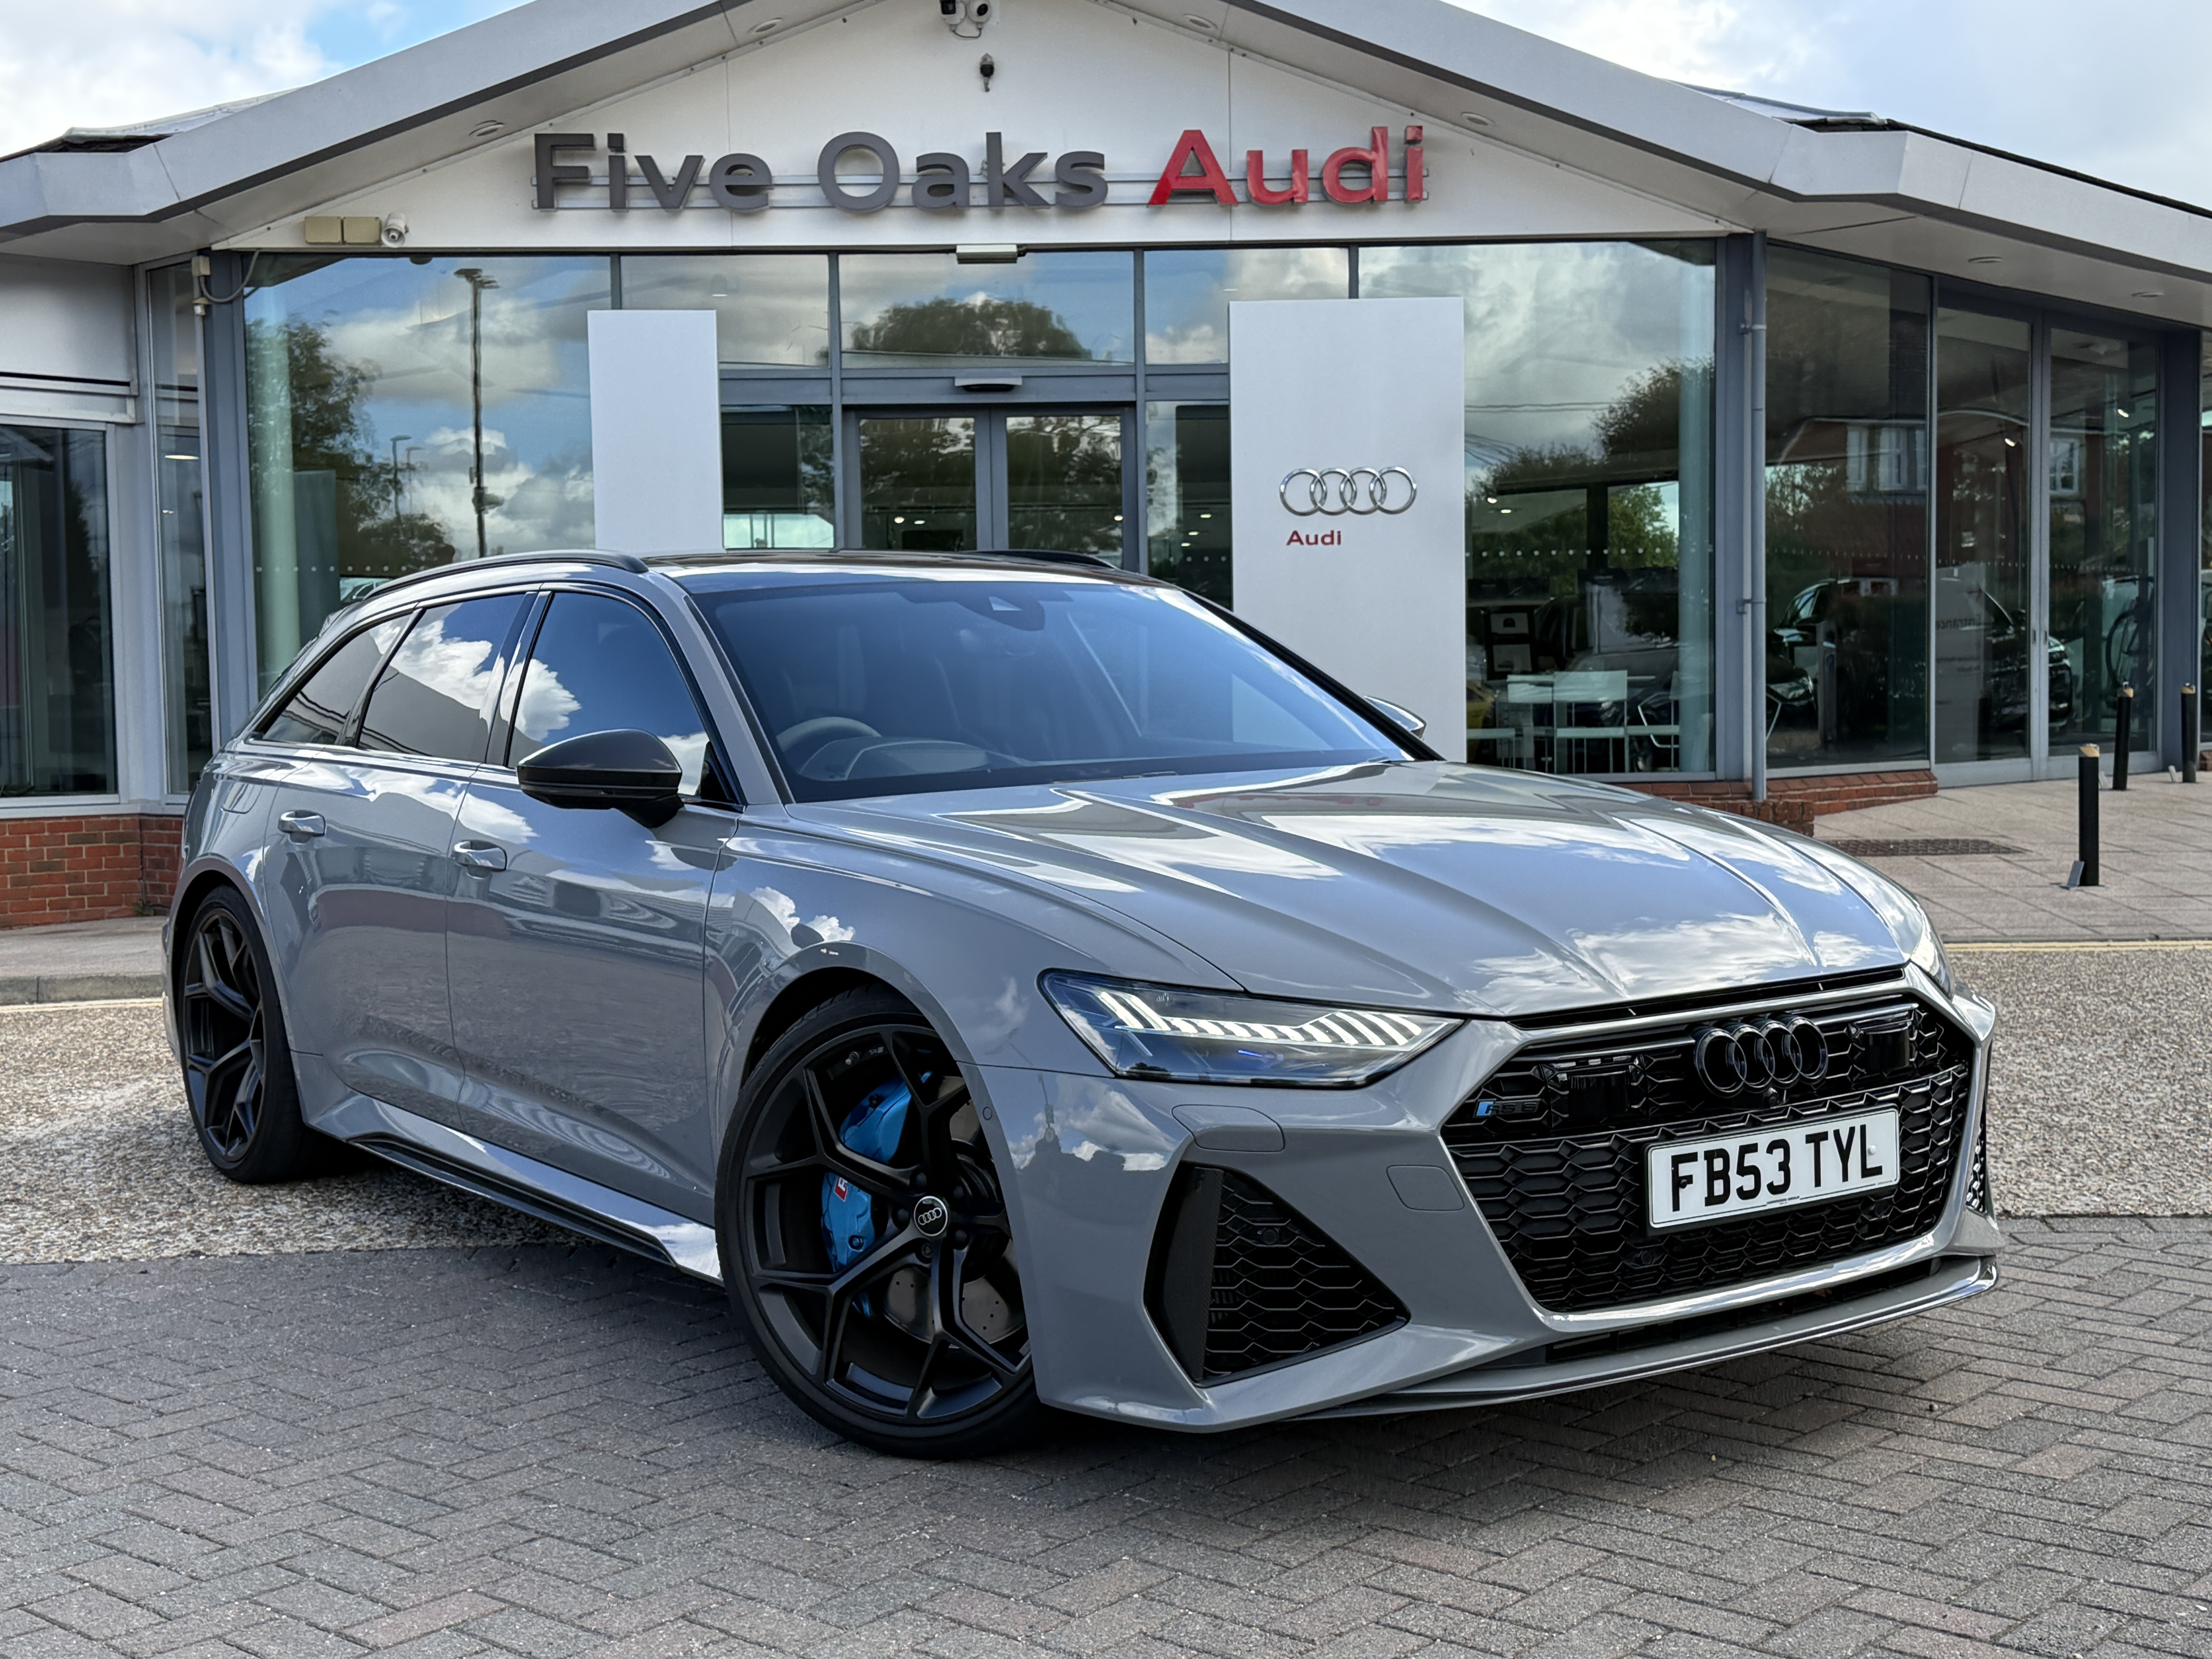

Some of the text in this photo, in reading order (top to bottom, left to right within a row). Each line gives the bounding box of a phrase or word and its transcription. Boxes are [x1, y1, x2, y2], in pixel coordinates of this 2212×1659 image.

[535, 125, 1424, 212] Five Oaks Audi
[1286, 530, 1341, 546] Audi
[1671, 1124, 1883, 1212] FB53 TYL
